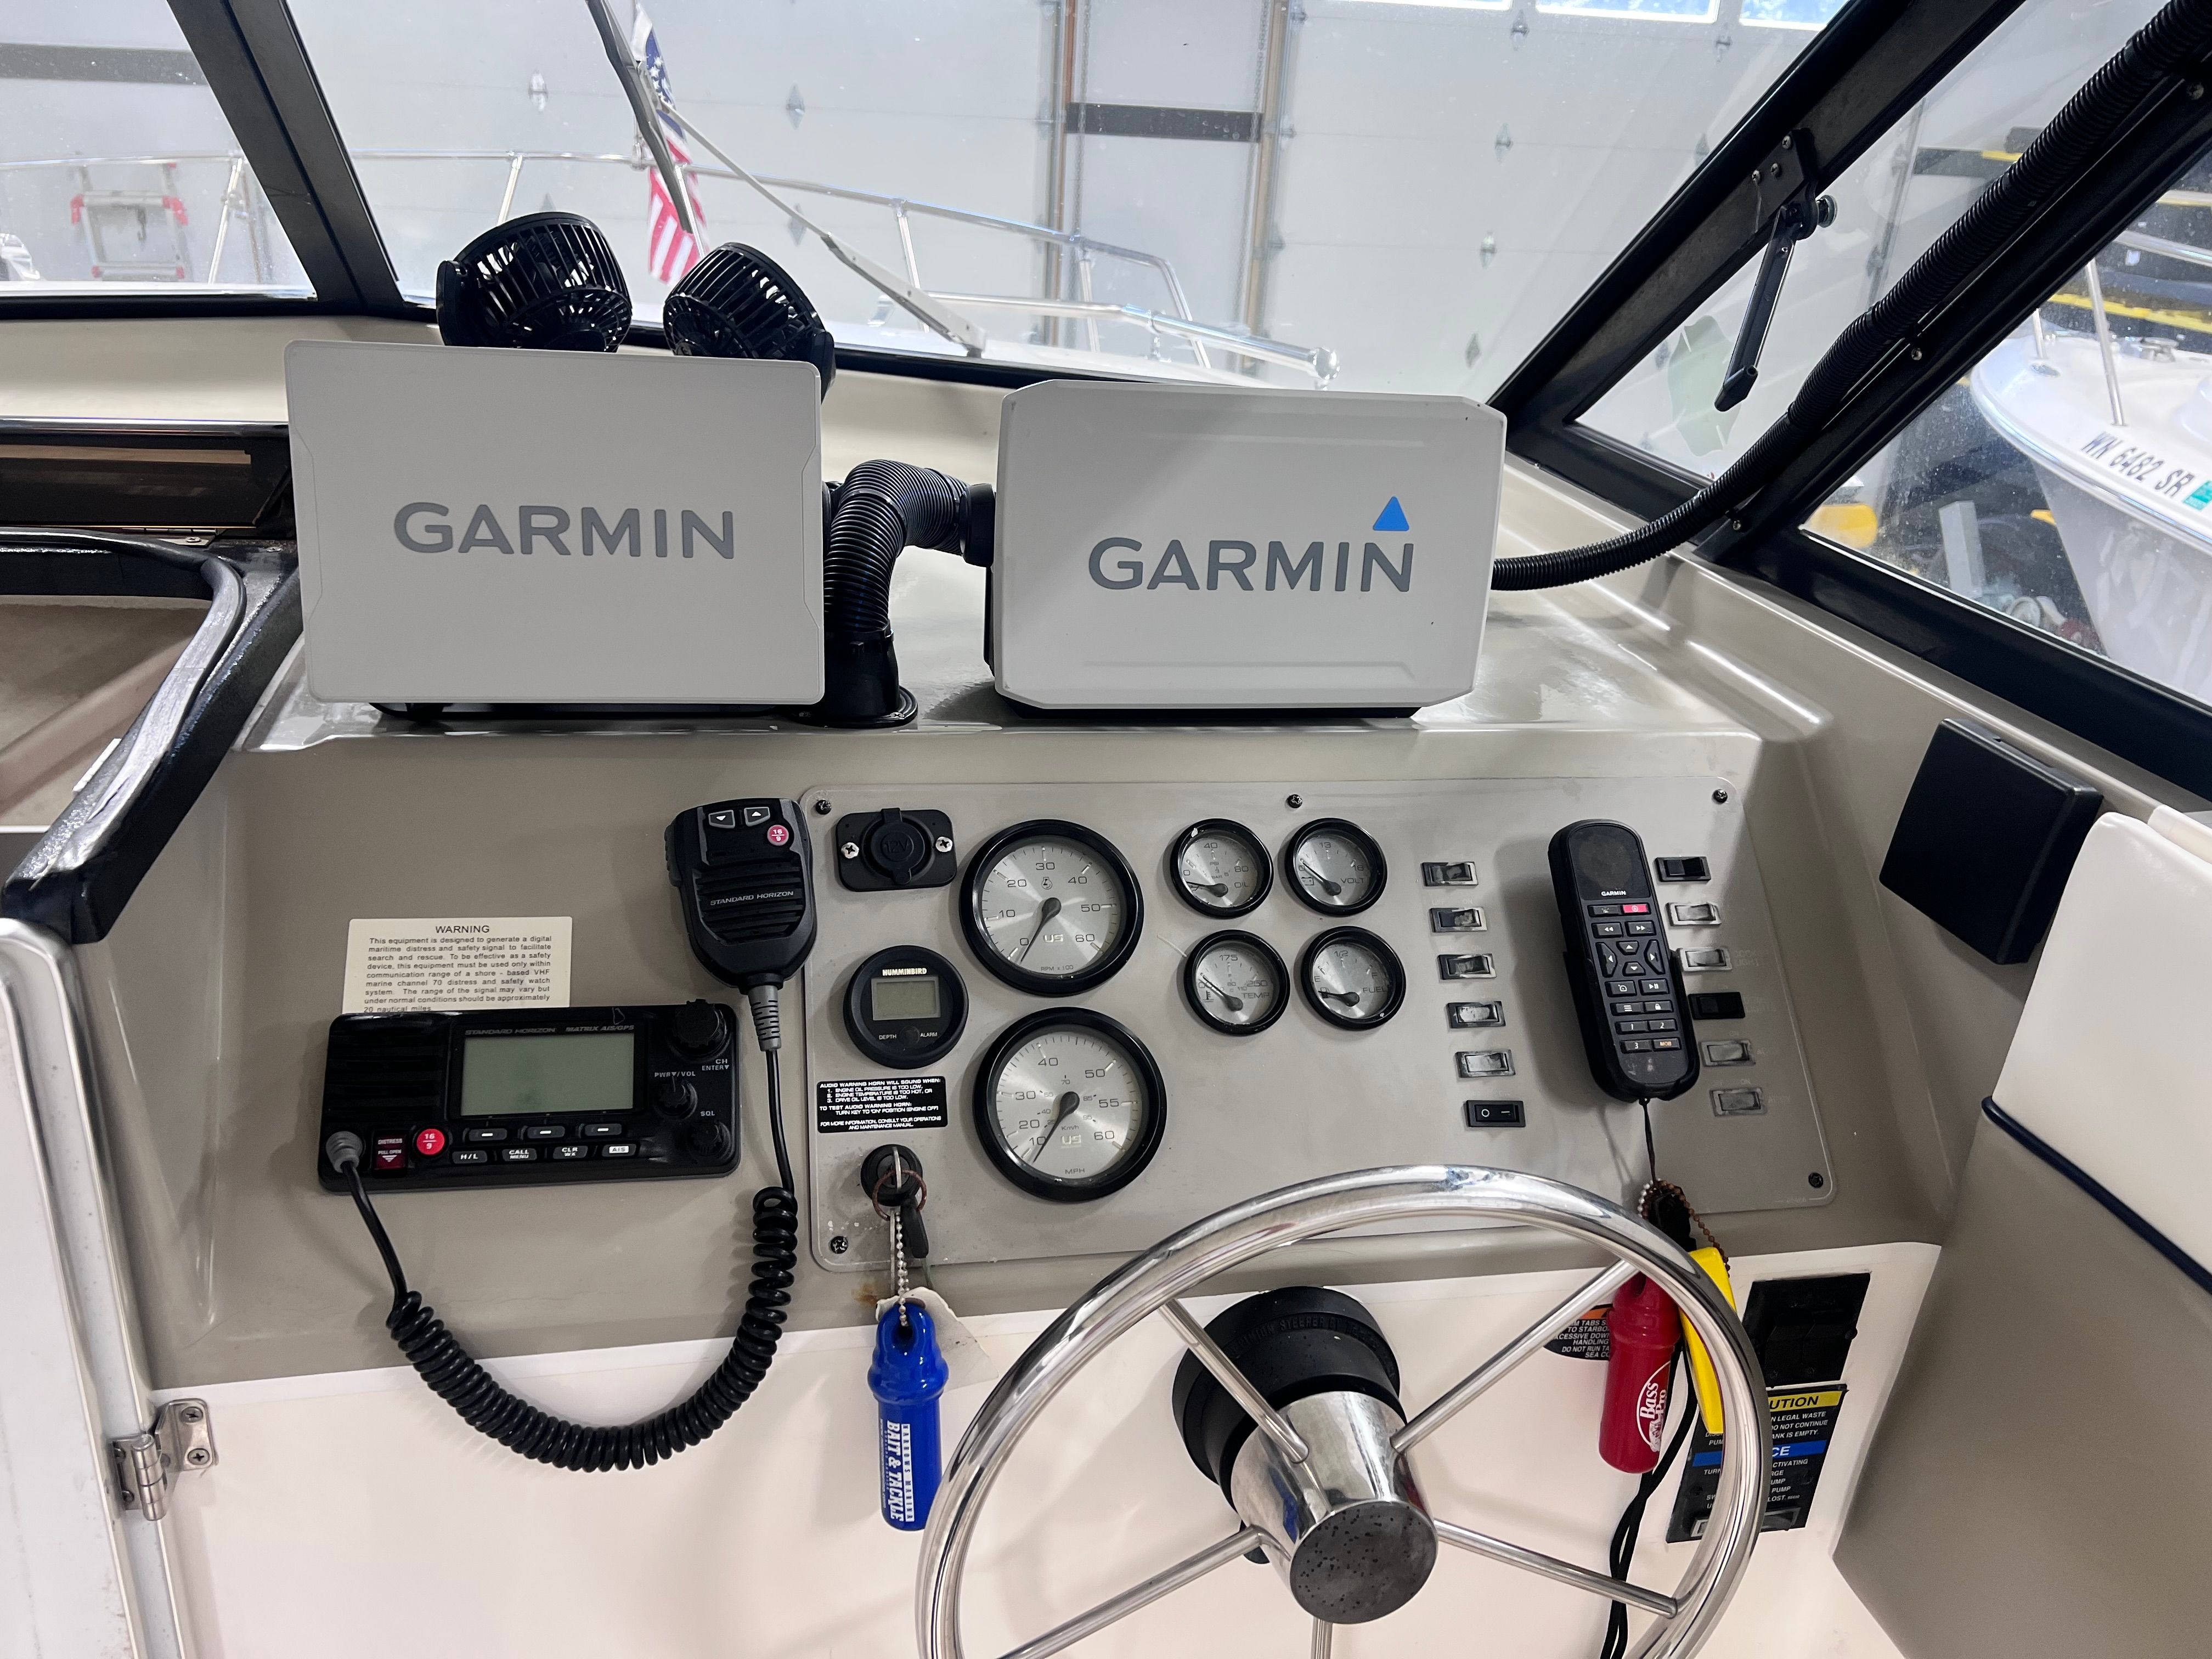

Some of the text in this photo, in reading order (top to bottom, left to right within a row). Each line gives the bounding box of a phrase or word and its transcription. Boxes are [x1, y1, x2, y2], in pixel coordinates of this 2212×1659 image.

[2109, 447, 2164, 481] 6482
[2154, 469, 2195, 498] SR
[394, 502, 733, 559] GARMIN
[1088, 537, 1414, 592] GARMIN
[885, 839, 910, 853] 12V
[1036, 862, 1055, 870] 30
[1007, 879, 1026, 888] 20
[1068, 876, 1087, 884] 40
[710, 890, 794, 906] STANDARD HORIZON
[1081, 904, 1101, 912] 50
[1019, 938, 1029, 946] 0
[1044, 934, 1063, 943] US
[1075, 934, 1095, 943] 60
[882, 968, 927, 976] HUMMINBIRD
[1038, 1058, 1058, 1066] 40
[1085, 1069, 1105, 1078] 50
[1015, 1091, 1036, 1100] 30
[1099, 1098, 1119, 1108] 55
[1019, 1120, 1040, 1129] 20
[1062, 1135, 1081, 1144] US
[1094, 1131, 1114, 1140] 60
[1029, 1136, 1047, 1146] 10
[1639, 1382, 1658, 1419] Bass
[1655, 1389, 1666, 1414] Pro
[1770, 1396, 1819, 1409] UTION
[1795, 1420, 1829, 1429] CONTINUE
[1773, 1459, 1808, 1468] CTIVATING
[887, 1420, 904, 1522] BAIT & TACKLE
